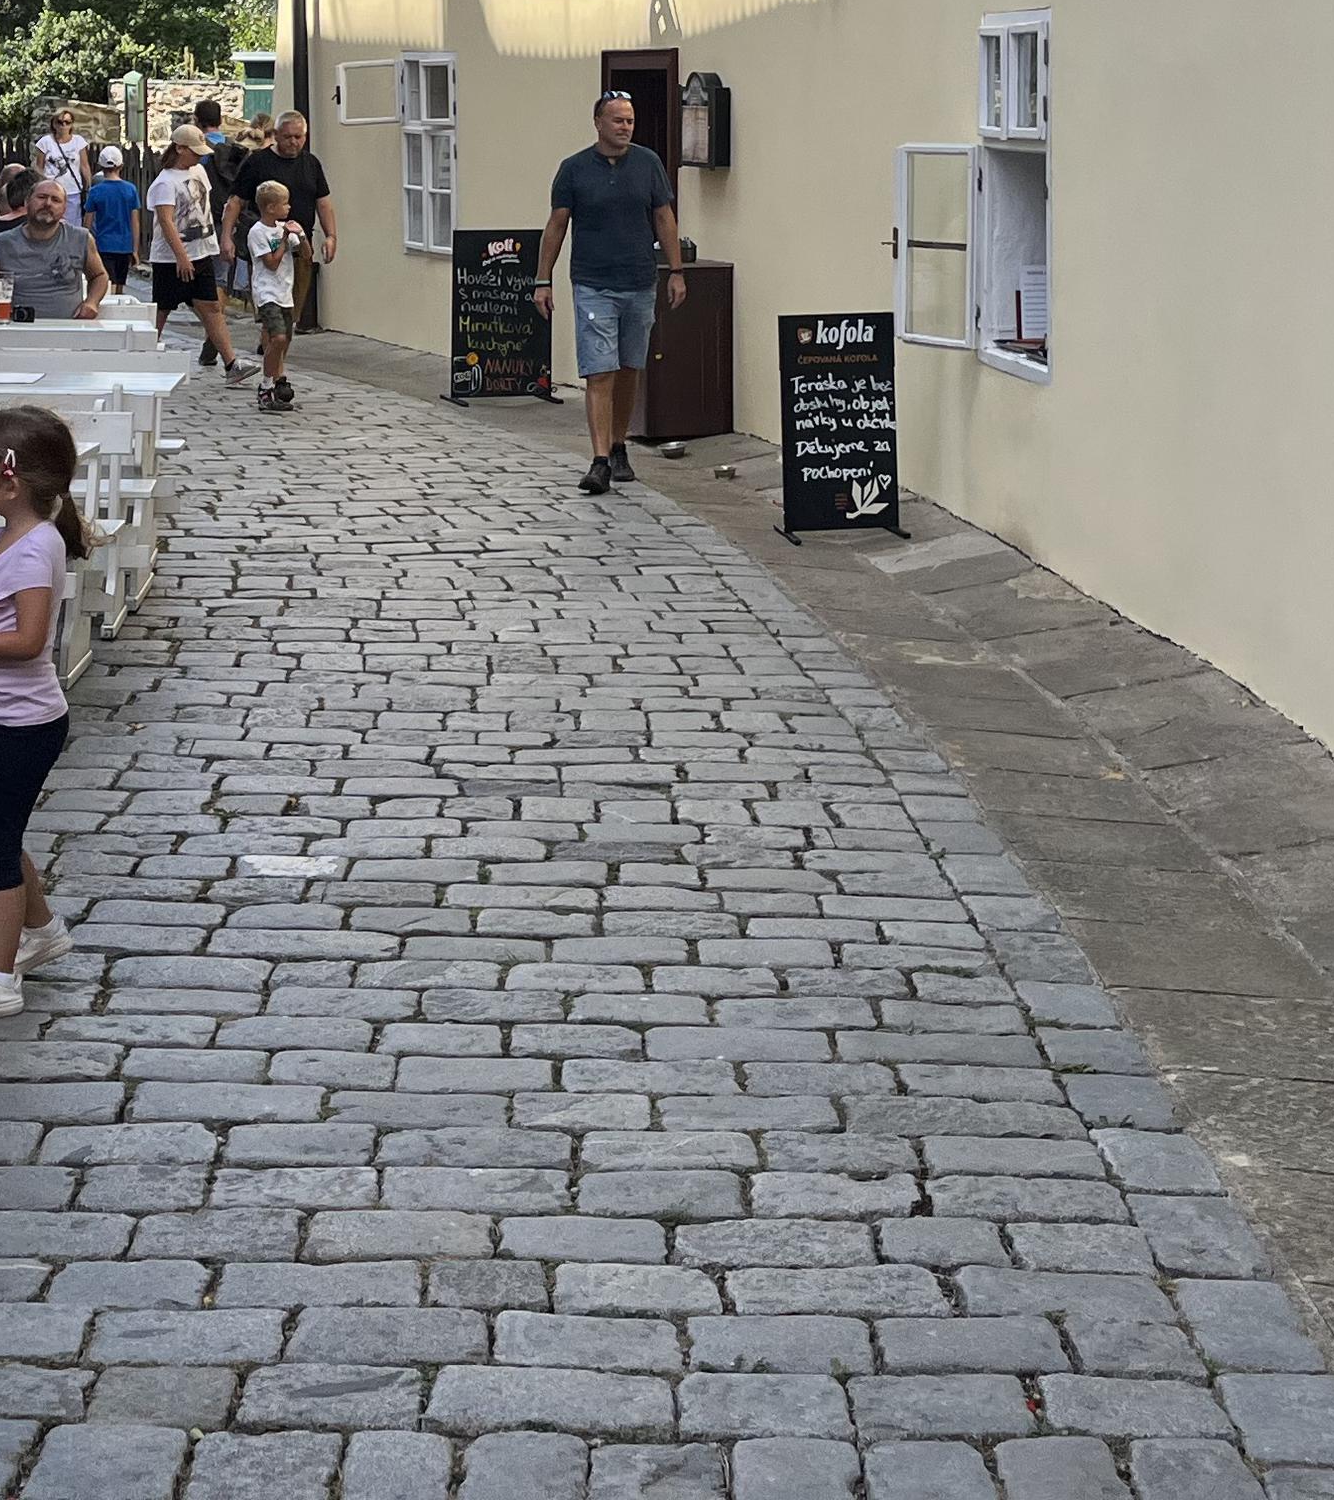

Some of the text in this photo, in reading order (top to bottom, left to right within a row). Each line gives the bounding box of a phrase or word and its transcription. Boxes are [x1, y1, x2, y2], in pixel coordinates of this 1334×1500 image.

[506, 271, 536, 292] výva
[472, 290, 519, 301] masem
[524, 292, 535, 303] a
[460, 301, 518, 315] nudlemi
[459, 315, 534, 335] Minutková
[815, 318, 875, 350] kofola
[851, 374, 867, 394] je
[870, 374, 893, 392] bez
[841, 418, 853, 428] u
[795, 437, 891, 460] Děkujeme za
[801, 460, 874, 482] pochopení
